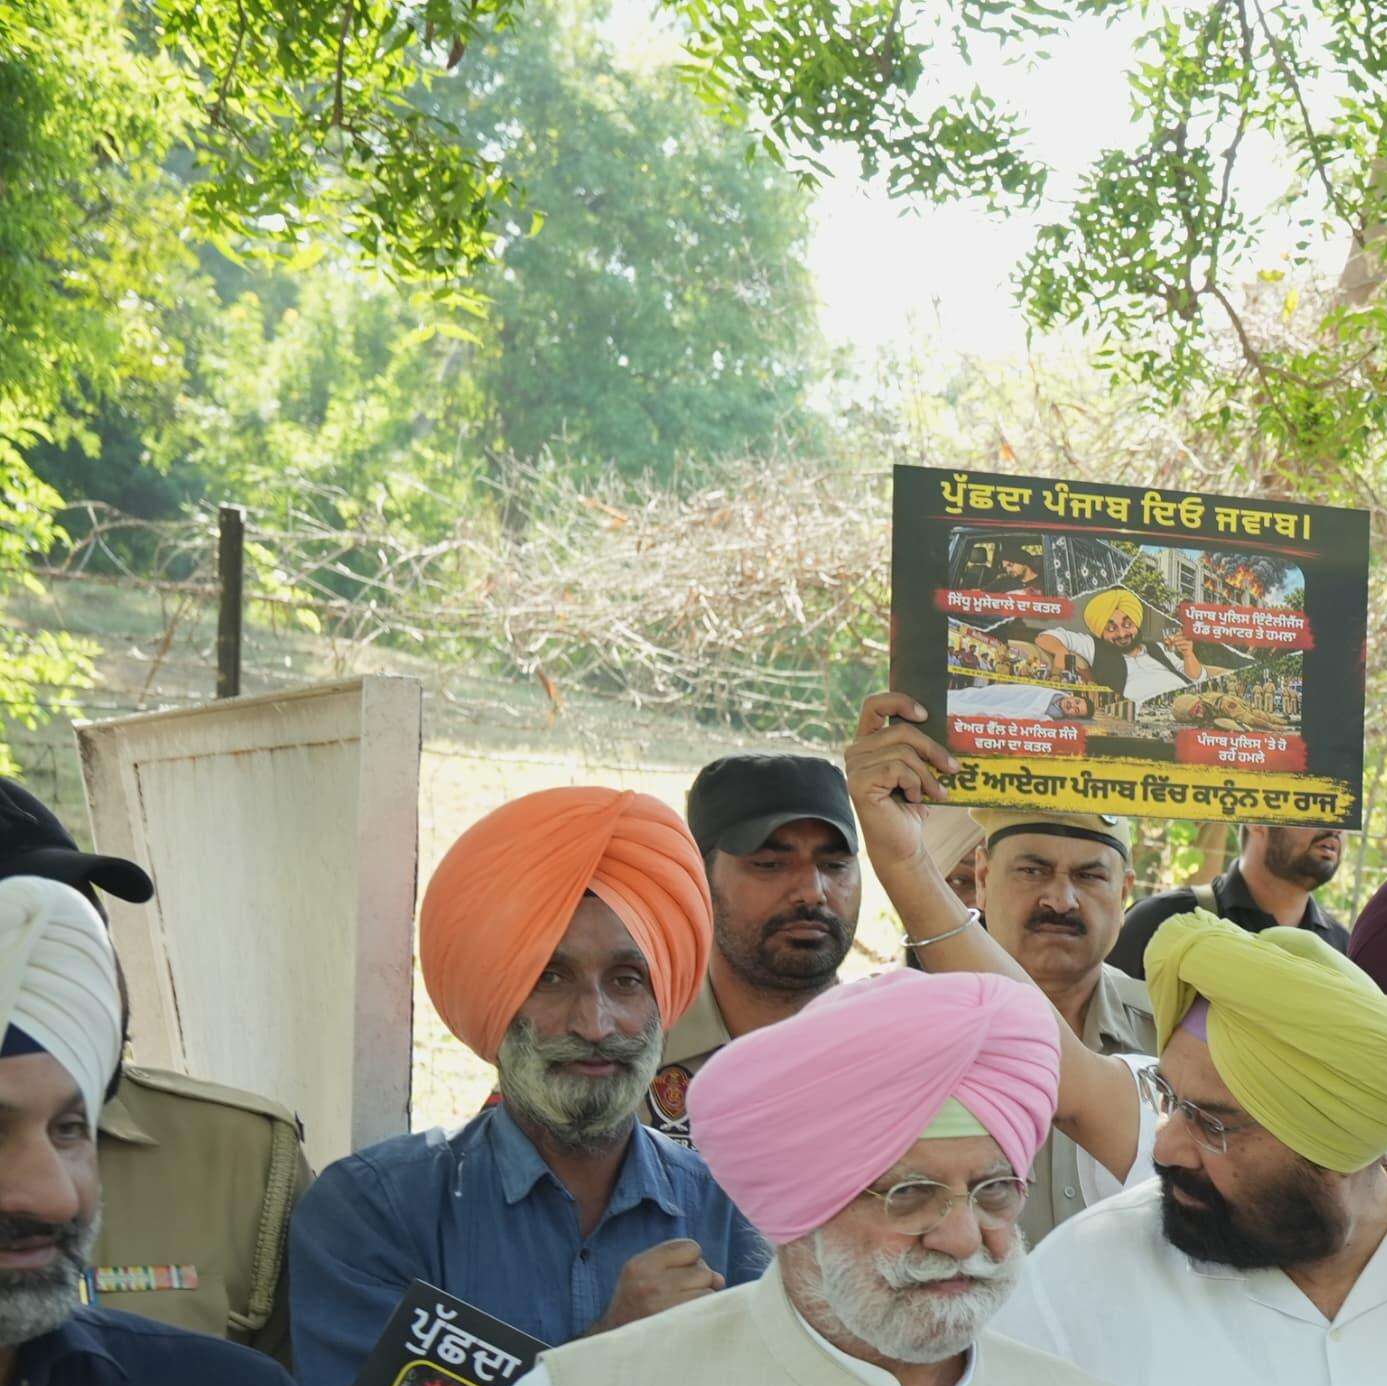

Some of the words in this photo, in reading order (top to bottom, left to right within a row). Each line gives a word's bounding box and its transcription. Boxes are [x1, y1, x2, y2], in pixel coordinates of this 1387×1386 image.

[940, 475, 1032, 514] ਪੁੱਛਦਾ
[1042, 485, 1130, 524] ਪੰਜਾਬ
[1142, 491, 1204, 529] ਦਿਓ
[1215, 506, 1311, 540] ਜਵਾਬ।
[980, 765, 1067, 797] ਆਏਗਾ
[1071, 770, 1136, 801] ਪੰਜਾਬ
[1141, 778, 1187, 805] ਵਿੱਚ
[1191, 787, 1259, 815] ਕਾਨੂੰਨ
[405, 1303, 520, 1379] ਪੁੱਛਦਾ
